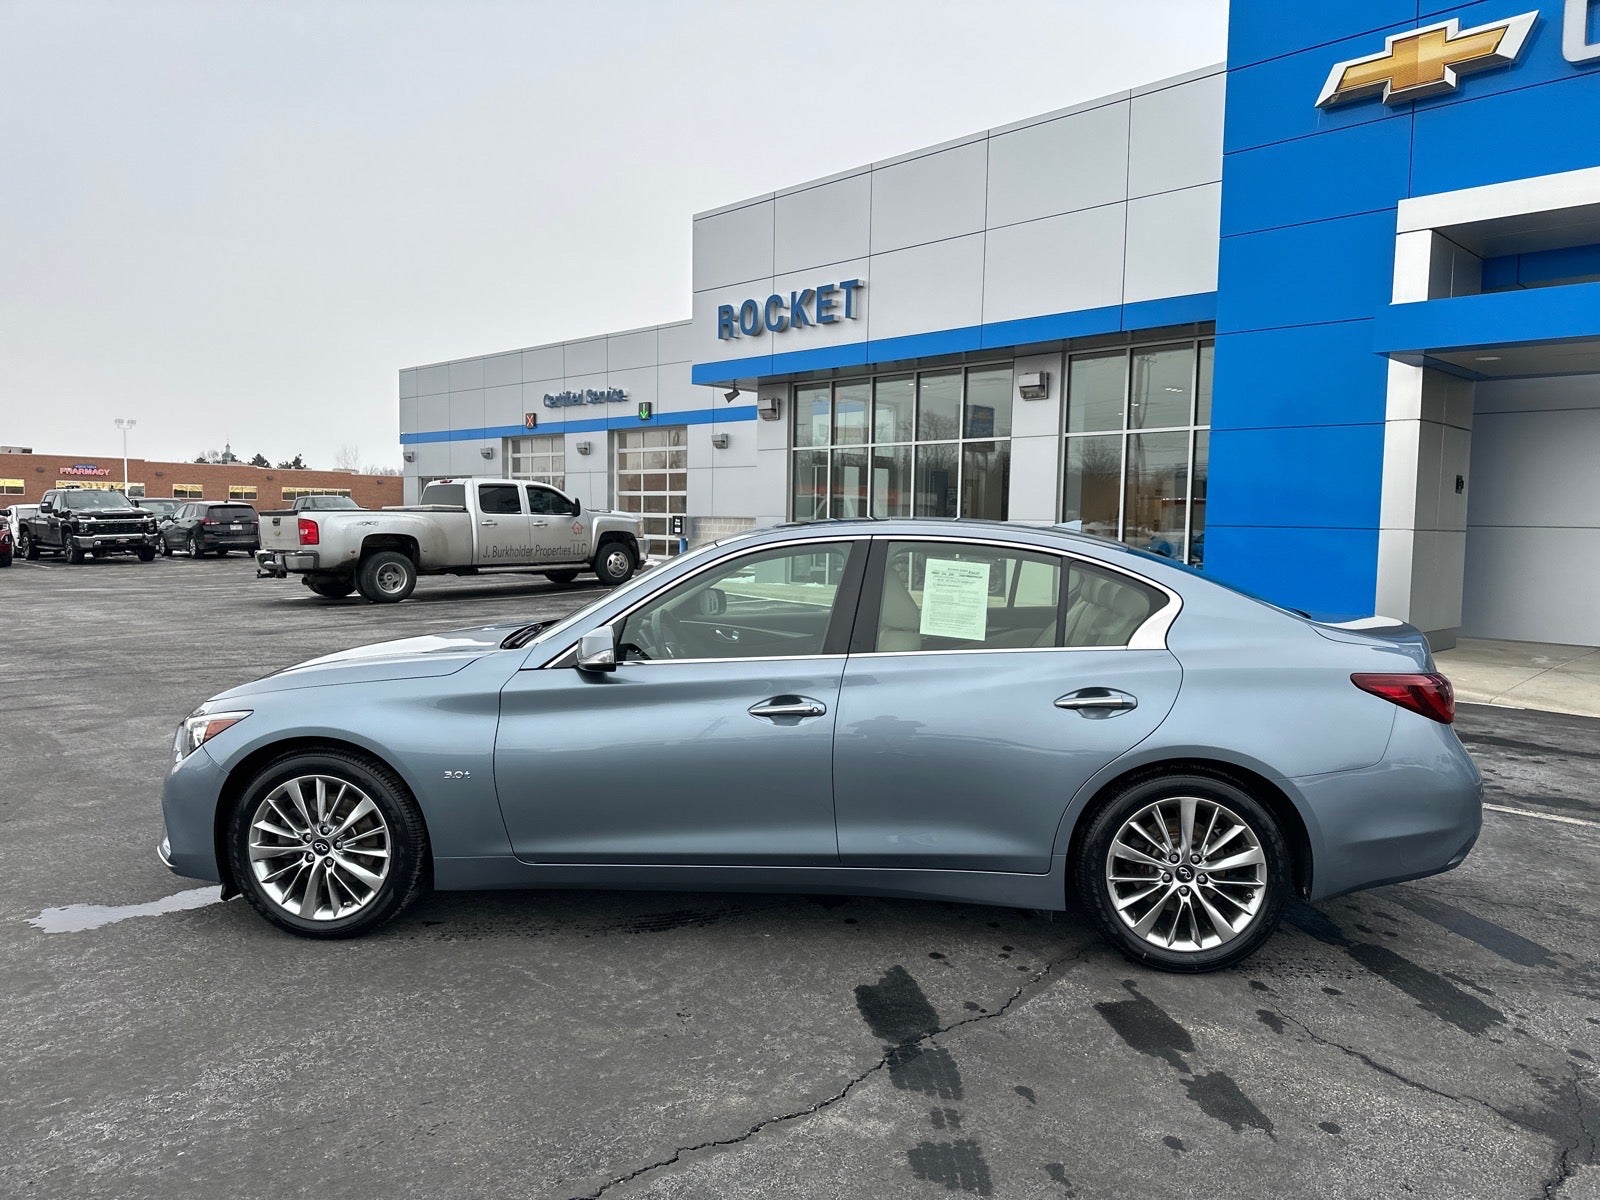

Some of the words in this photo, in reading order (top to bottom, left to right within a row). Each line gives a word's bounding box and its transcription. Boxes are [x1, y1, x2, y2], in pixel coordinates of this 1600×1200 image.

[718, 278, 865, 340] ROCKET
[543, 389, 586, 408] Certified
[586, 387, 627, 404] Service
[59, 468, 110, 476] PHARMACY
[482, 546, 490, 558] J.
[492, 545, 533, 558] Burkholder
[535, 544, 571, 558] Properties
[572, 543, 587, 556] LLC
